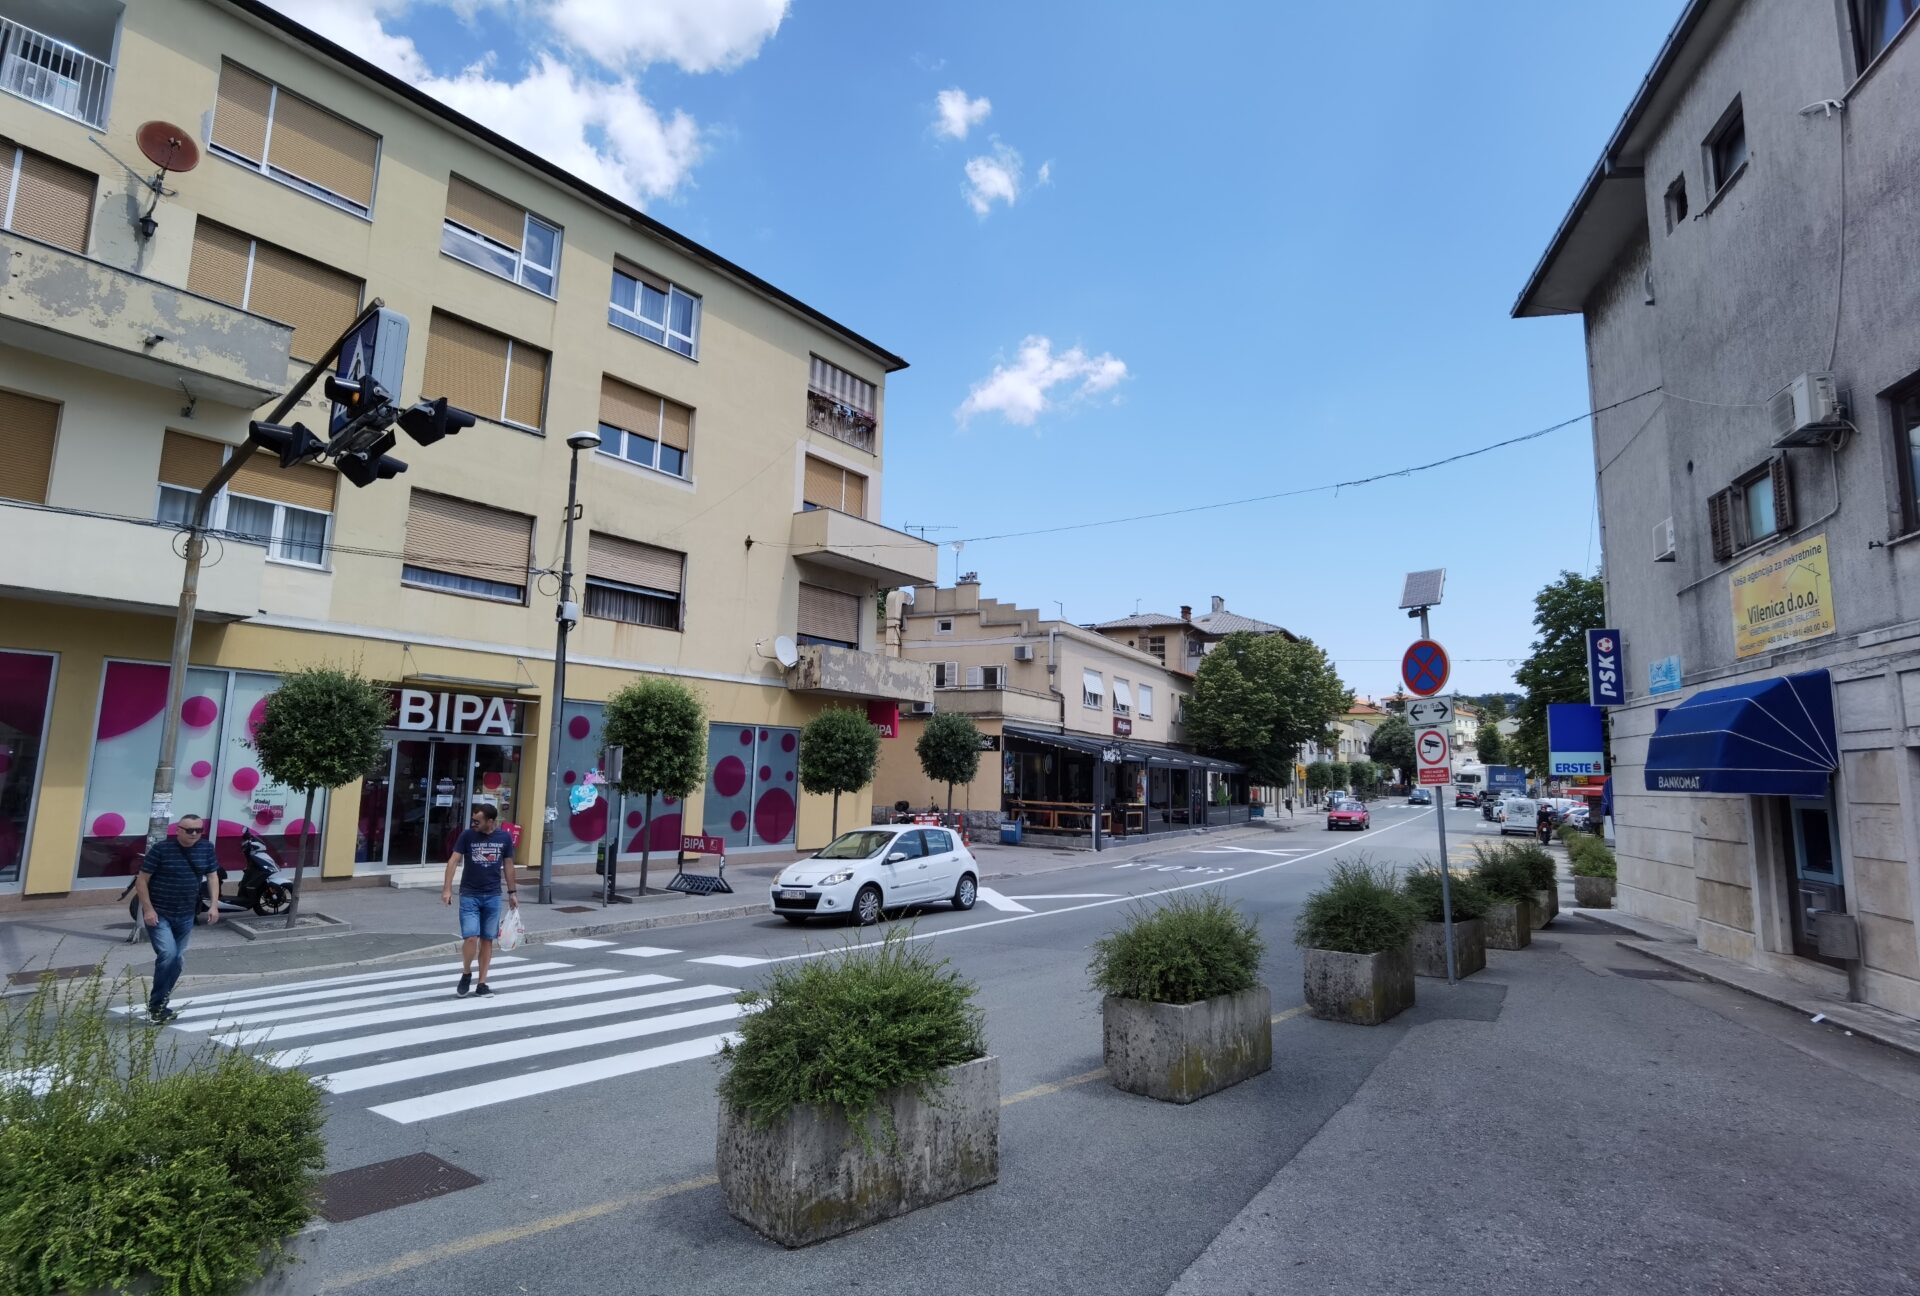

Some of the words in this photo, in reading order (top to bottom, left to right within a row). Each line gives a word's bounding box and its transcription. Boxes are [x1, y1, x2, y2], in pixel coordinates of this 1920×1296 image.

[1747, 564, 1773, 583] agencija
[1775, 562, 1782, 571] za
[1784, 544, 1822, 566] nekretnine
[1747, 600, 1785, 624] Vilenica
[1787, 591, 1818, 612] d.o.o.
[1598, 653, 1617, 698] PSK
[399, 688, 512, 736] BIPA
[1555, 763, 1592, 773] ERSTE
[1658, 776, 1700, 789] BANKOMAT
[683, 837, 705, 850] BIPA
